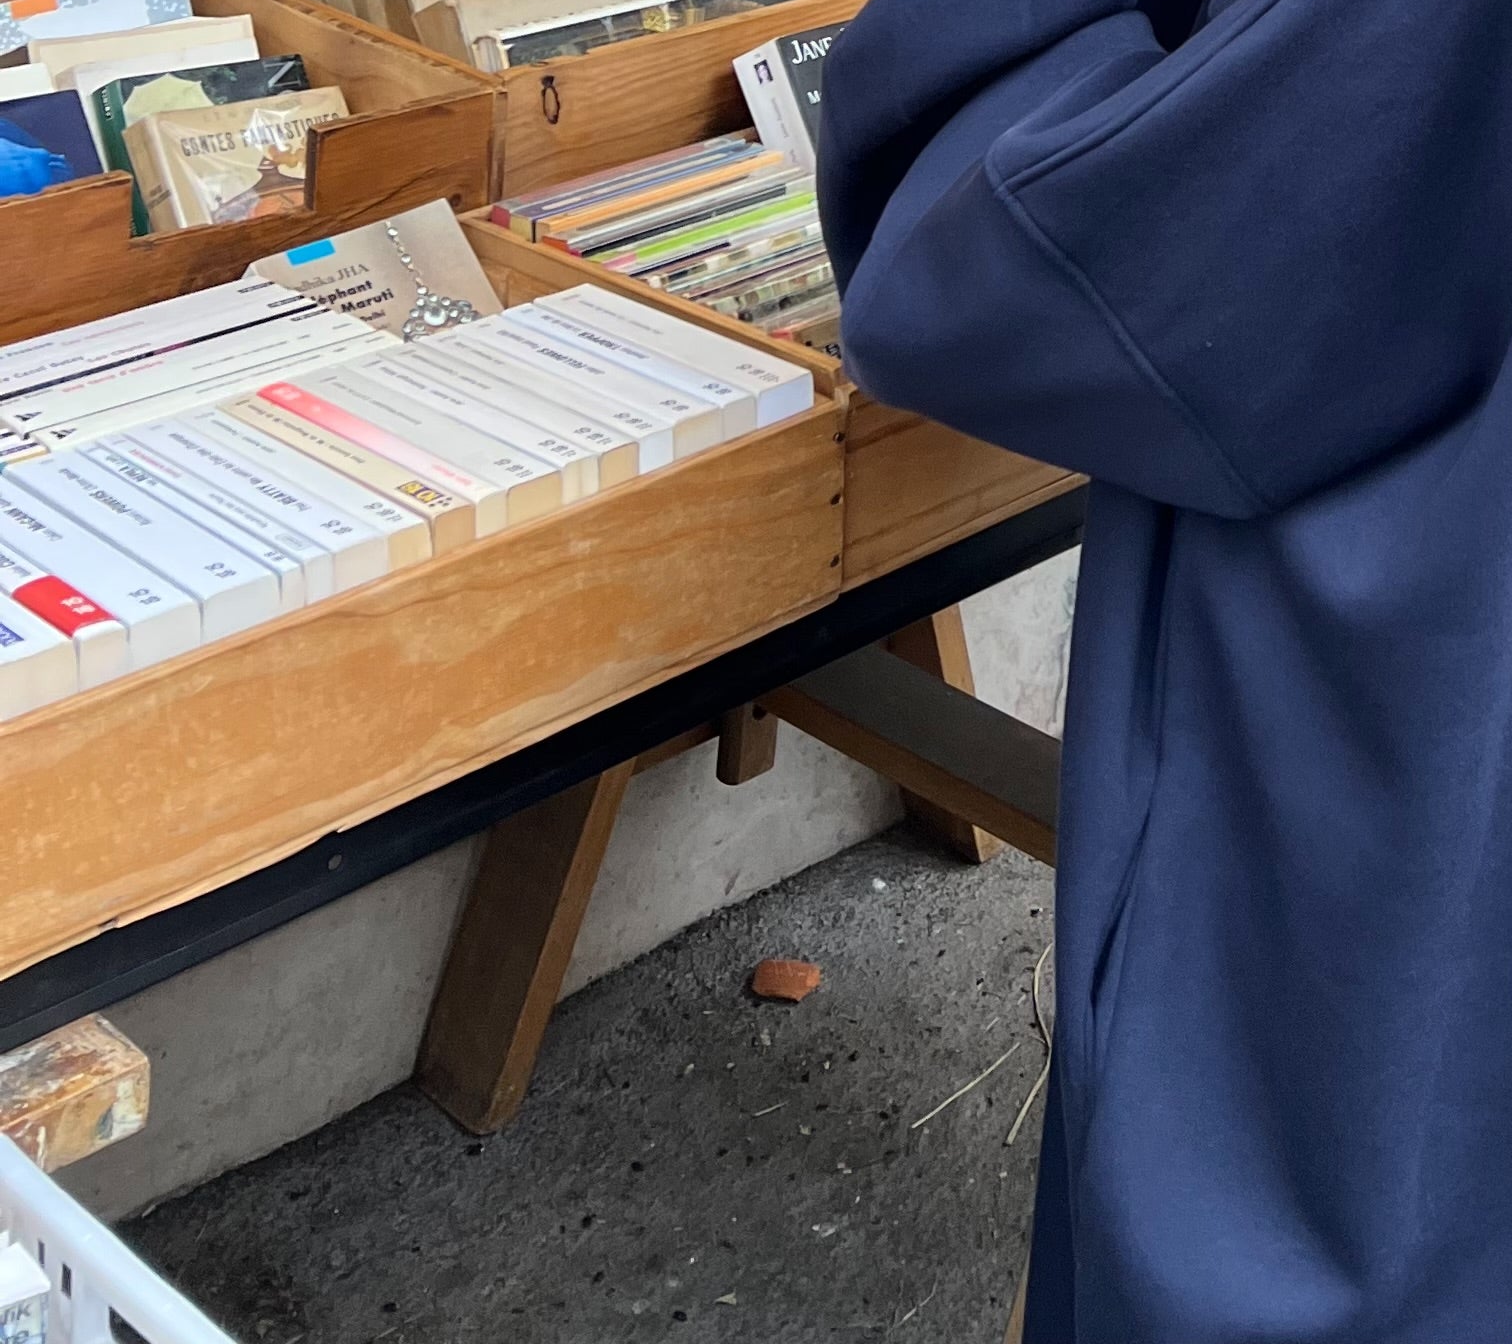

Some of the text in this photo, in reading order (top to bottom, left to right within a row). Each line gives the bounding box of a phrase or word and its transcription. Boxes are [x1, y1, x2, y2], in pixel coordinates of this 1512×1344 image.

[180, 131, 236, 158] CONTES
[337, 263, 370, 283] JHA
[311, 279, 374, 308] éphant
[341, 288, 394, 314] Maruti
